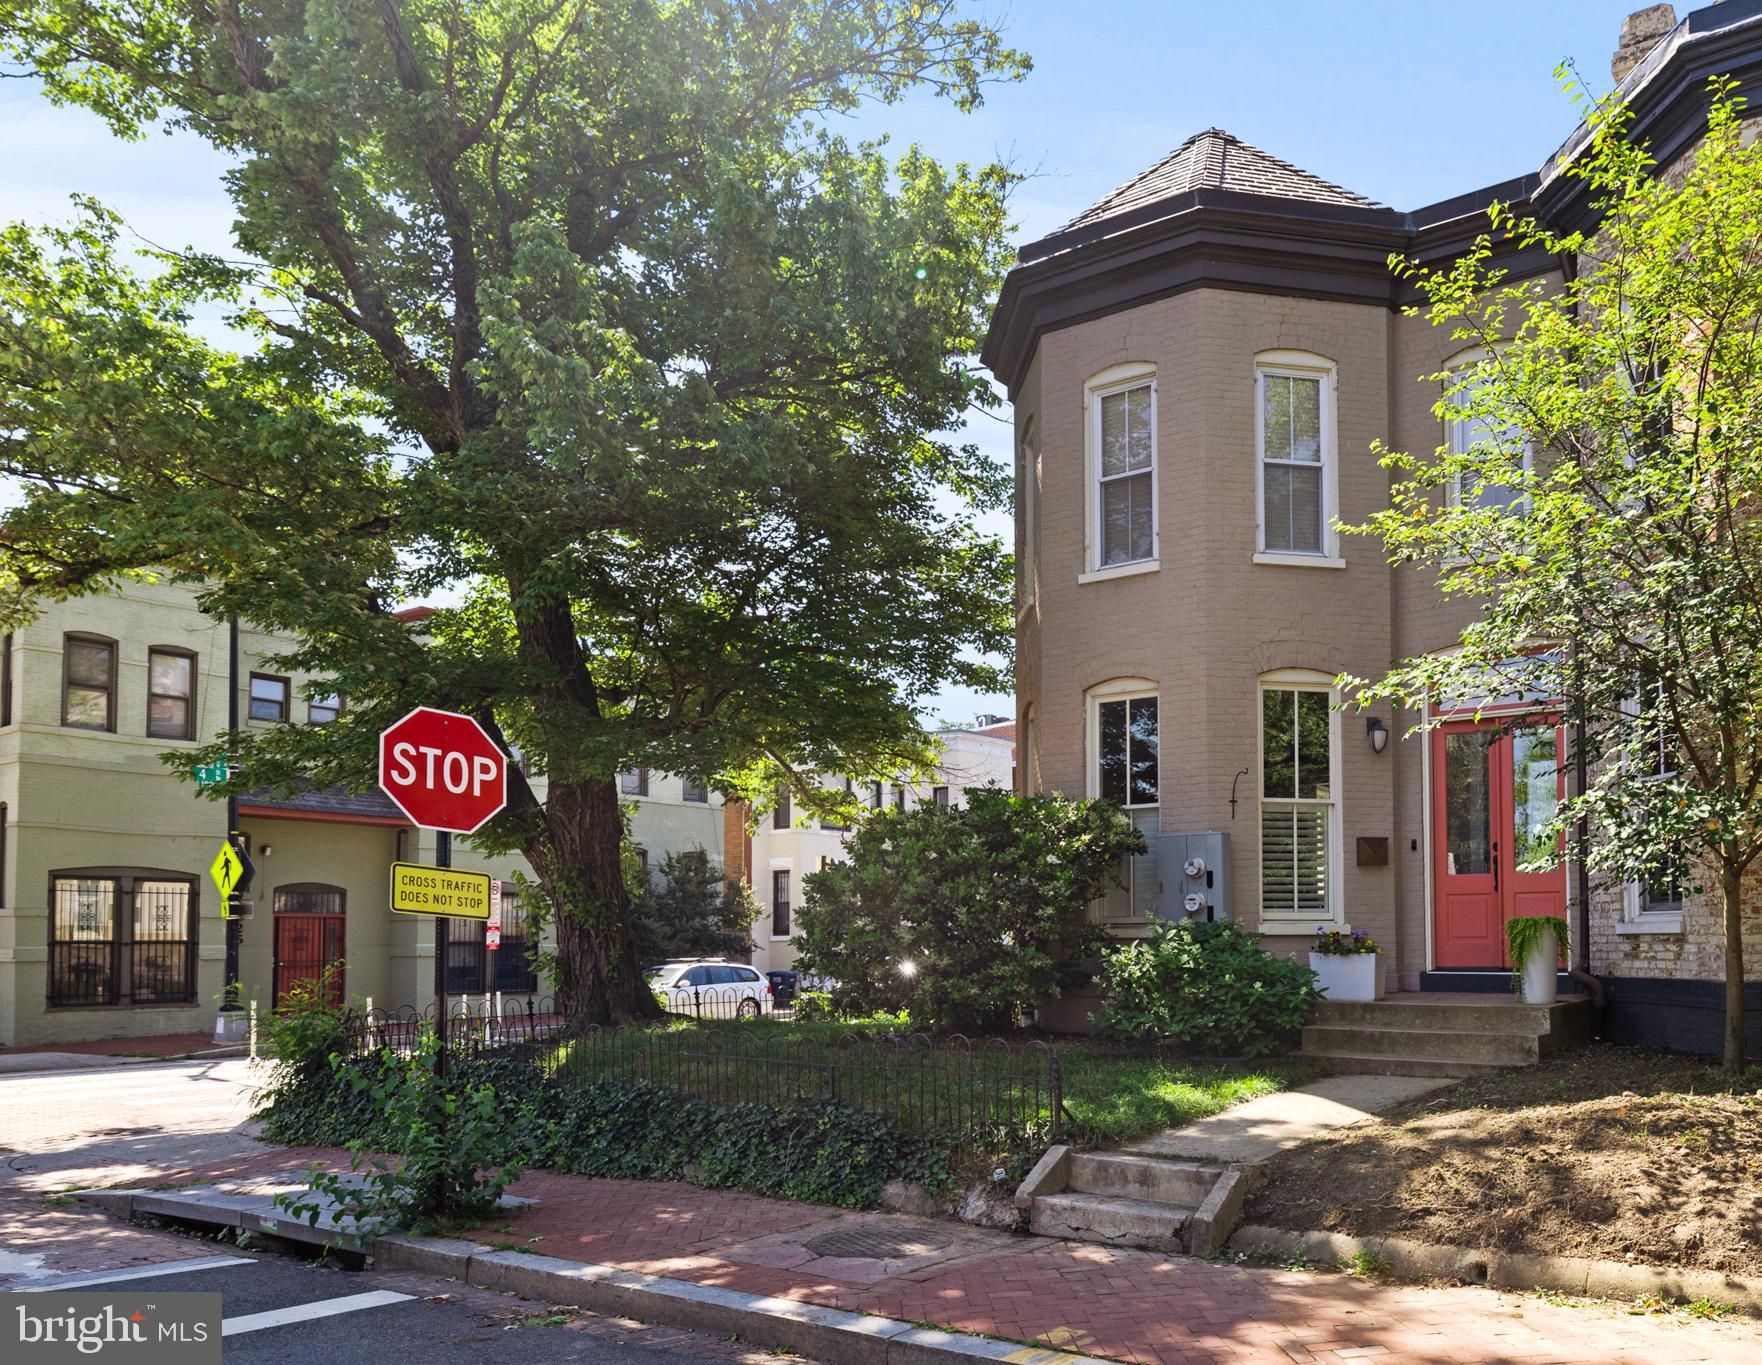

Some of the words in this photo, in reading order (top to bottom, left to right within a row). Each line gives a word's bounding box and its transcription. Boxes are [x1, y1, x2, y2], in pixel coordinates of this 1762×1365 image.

[390, 741, 498, 797] STOP
[401, 875, 437, 889] CROSS
[441, 879, 483, 894] TRAFFIC
[400, 890, 429, 904] DOES
[433, 894, 453, 906] NOT
[457, 896, 484, 909] STOP
